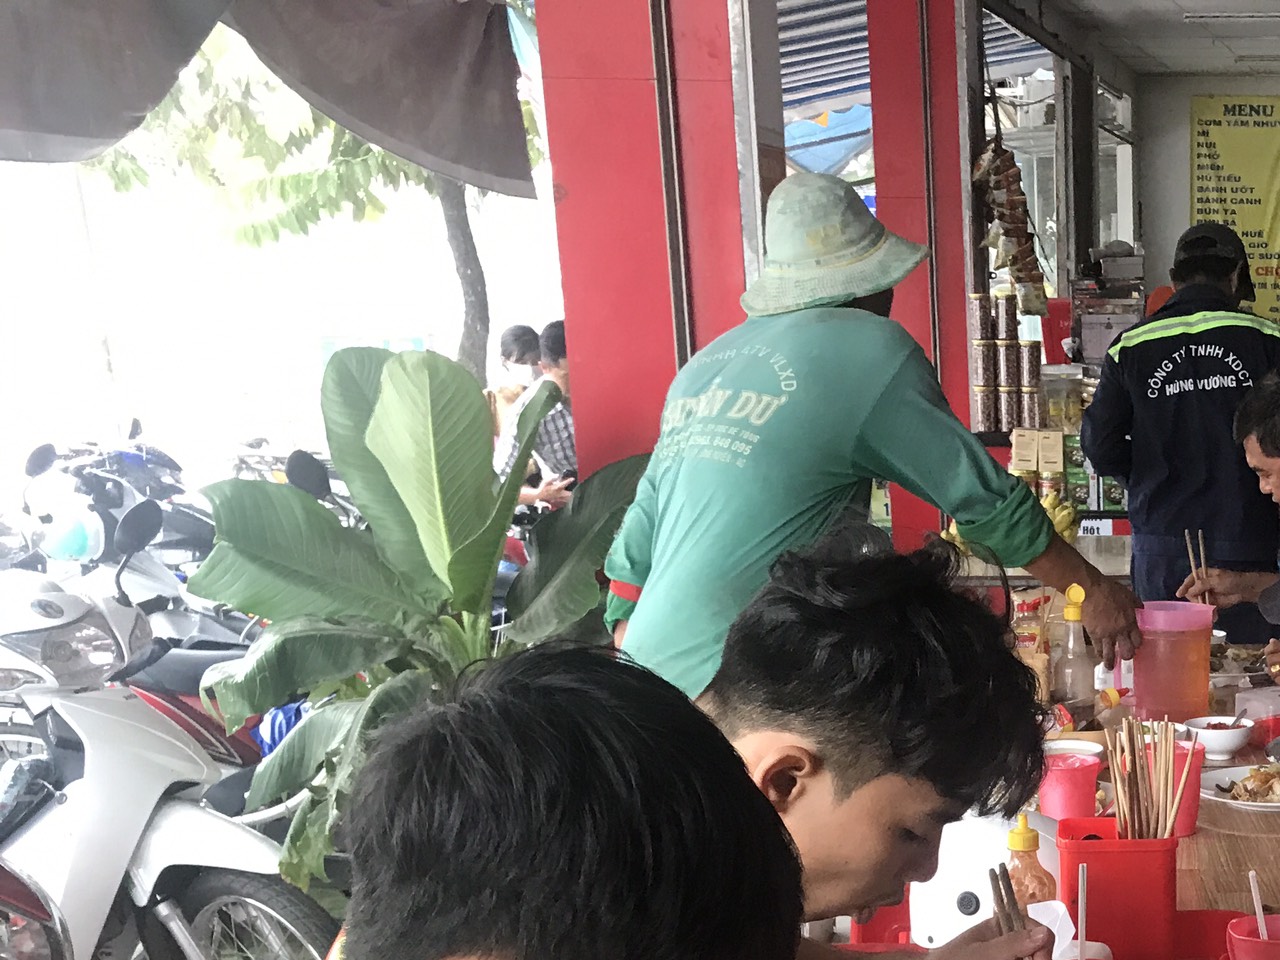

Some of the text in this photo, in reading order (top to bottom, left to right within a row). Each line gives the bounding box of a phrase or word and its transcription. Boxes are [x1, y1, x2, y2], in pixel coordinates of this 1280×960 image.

[1222, 103, 1275, 117] MENU
[1196, 151, 1220, 160] PHỞ
[1222, 208, 1237, 216] TA
[1241, 229, 1264, 238] HUẾ
[769, 352, 798, 392] VLXD
[1147, 344, 1254, 398] CÔNG TY TNHH XDCT
[1165, 374, 1237, 396] HÙNG VƯƠNG
